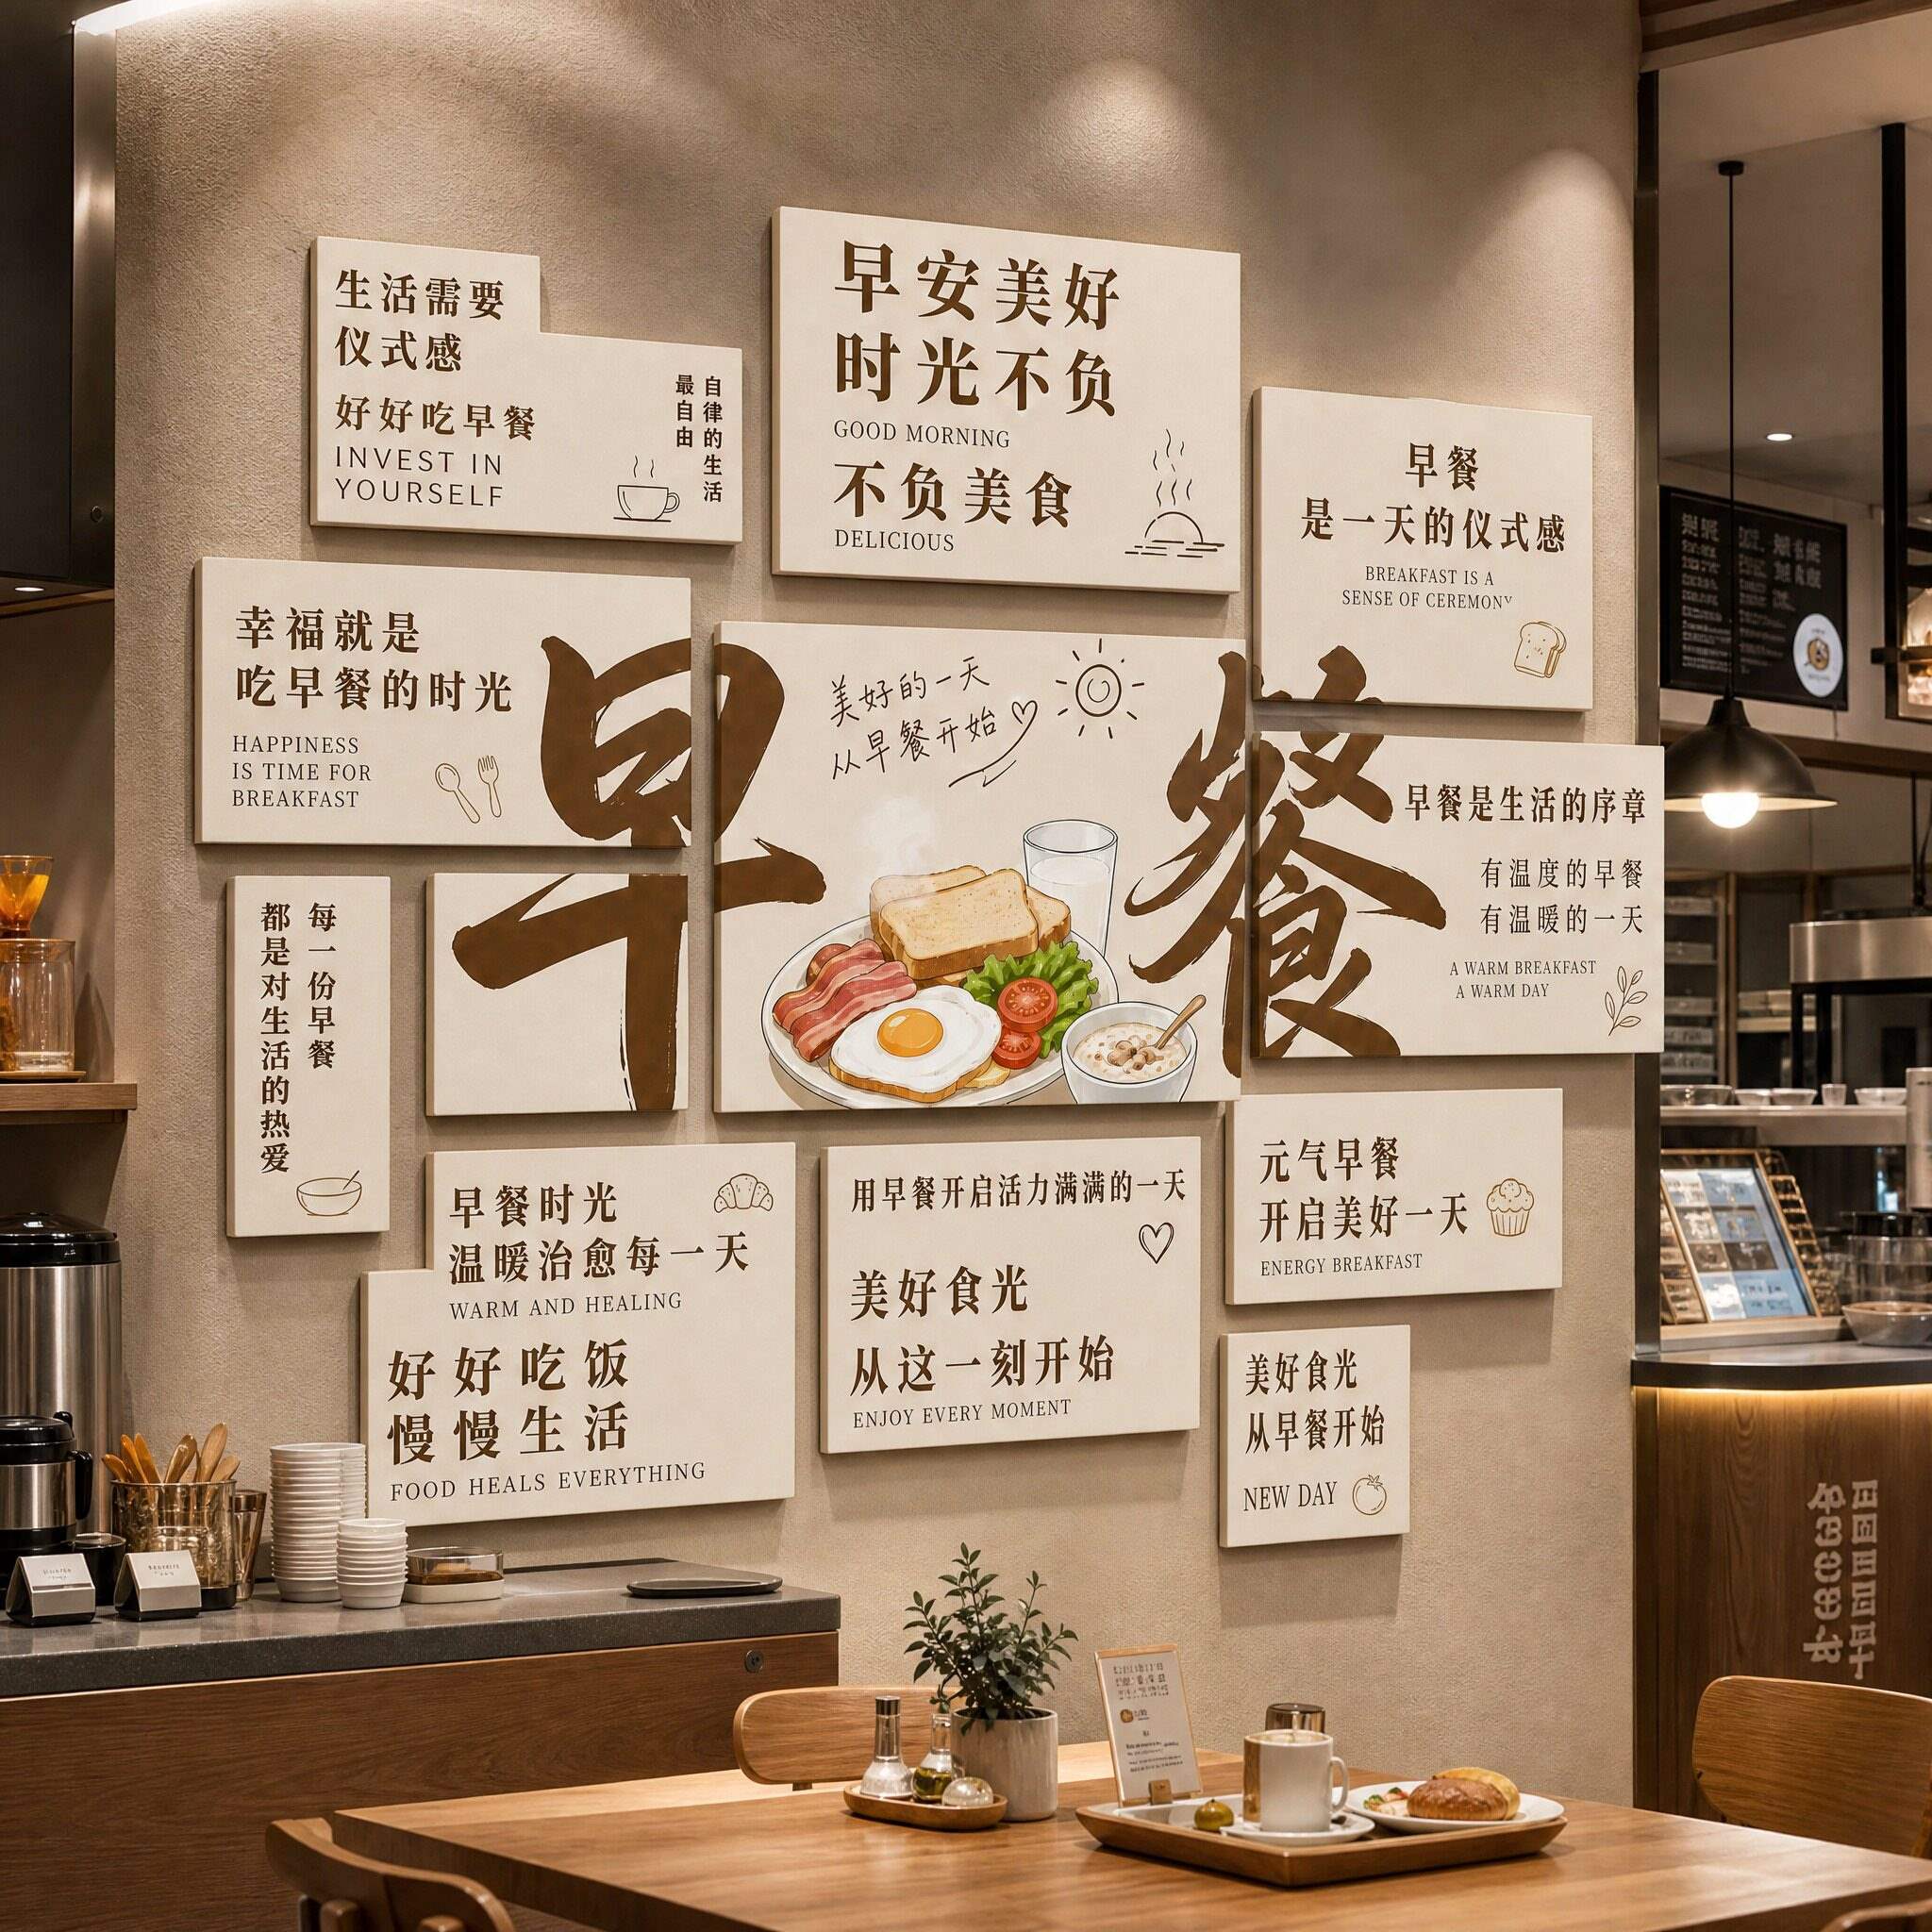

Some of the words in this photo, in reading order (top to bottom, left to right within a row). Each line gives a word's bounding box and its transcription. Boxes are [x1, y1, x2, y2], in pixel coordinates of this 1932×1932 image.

[335, 269, 505, 321] 生活需要
[834, 239, 1120, 330] 早安美好
[334, 325, 461, 373] 仪式感
[836, 331, 1115, 417] 时光不负
[335, 393, 536, 441] 好好吃早餐
[675, 374, 694, 448] 最自由
[834, 419, 896, 441] GOOD
[906, 424, 1009, 448] MORNING
[336, 445, 455, 473] INVEST
[472, 453, 501, 475] IN
[703, 375, 724, 503] 自律的生活
[1405, 441, 1479, 491] 早餐
[334, 477, 503, 507] YOURSELF
[833, 460, 1073, 528] 不负美食
[835, 528, 954, 552] DELICIOUS
[1300, 496, 1565, 553] 是一天的仪式感
[1342, 589, 1392, 607] SENSE
[1399, 591, 1420, 608] OF
[1365, 565, 1457, 585] BREAKFAST
[1463, 570, 1478, 585] IS
[1484, 571, 1494, 586] A
[235, 605, 420, 654] 幸福就是
[237, 663, 512, 713] 吃早餐的时光
[830, 657, 991, 727] 美好的一天
[233, 735, 358, 755] HAPPINESS
[832, 706, 997, 780] 从早餐开始
[232, 762, 253, 780] IS
[262, 762, 319, 781] TIME
[329, 763, 371, 782] FOR
[232, 790, 359, 808] BREAKFAST
[1404, 783, 1646, 824] 早餐是生活的序章
[1480, 858, 1643, 890] 有温度的早餐
[1480, 904, 1643, 935] 有温暖的一天
[307, 902, 337, 1070] 每一份早餐
[1449, 961, 1459, 976] A
[1464, 960, 1508, 975] WARM
[1515, 959, 1594, 974] BREAKFAST
[1456, 984, 1465, 999] A
[1471, 983, 1515, 998] WARM
[1522, 983, 1548, 998] DAY
[259, 902, 291, 1174] 都是对生活的热爱
[1259, 1136, 1399, 1185] 元气早餐
[449, 1181, 617, 1229] 早餐时光
[851, 1168, 1186, 1213] 用早餐开启活力满满的一天
[1259, 1191, 1468, 1243] 开启美好一天
[448, 1230, 749, 1286] 温暖治愈每一天
[1260, 1257, 1325, 1276] ENERGY
[1332, 1253, 1423, 1273] BREAKFAST
[449, 1300, 519, 1321] WARM
[529, 1297, 575, 1317] AND
[585, 1291, 681, 1313] HEALING
[850, 1264, 1028, 1322] 美好食光
[387, 1338, 628, 1403] 好好吃饭
[849, 1334, 1114, 1397] 从这一刻开始
[1245, 1348, 1357, 1397] 美好食光
[386, 1400, 628, 1466] 慢慢生活
[853, 1408, 914, 1428] ENJOY
[923, 1404, 983, 1424] EVERY
[991, 1398, 1072, 1420] MOMENT
[1245, 1404, 1385, 1455] 从早餐开始
[391, 1480, 456, 1502] FOOD
[469, 1473, 545, 1496] HEALS
[558, 1461, 705, 1490] EVERYTHING
[1243, 1484, 1291, 1512] NEW
[1297, 1480, 1338, 1507] DAY
